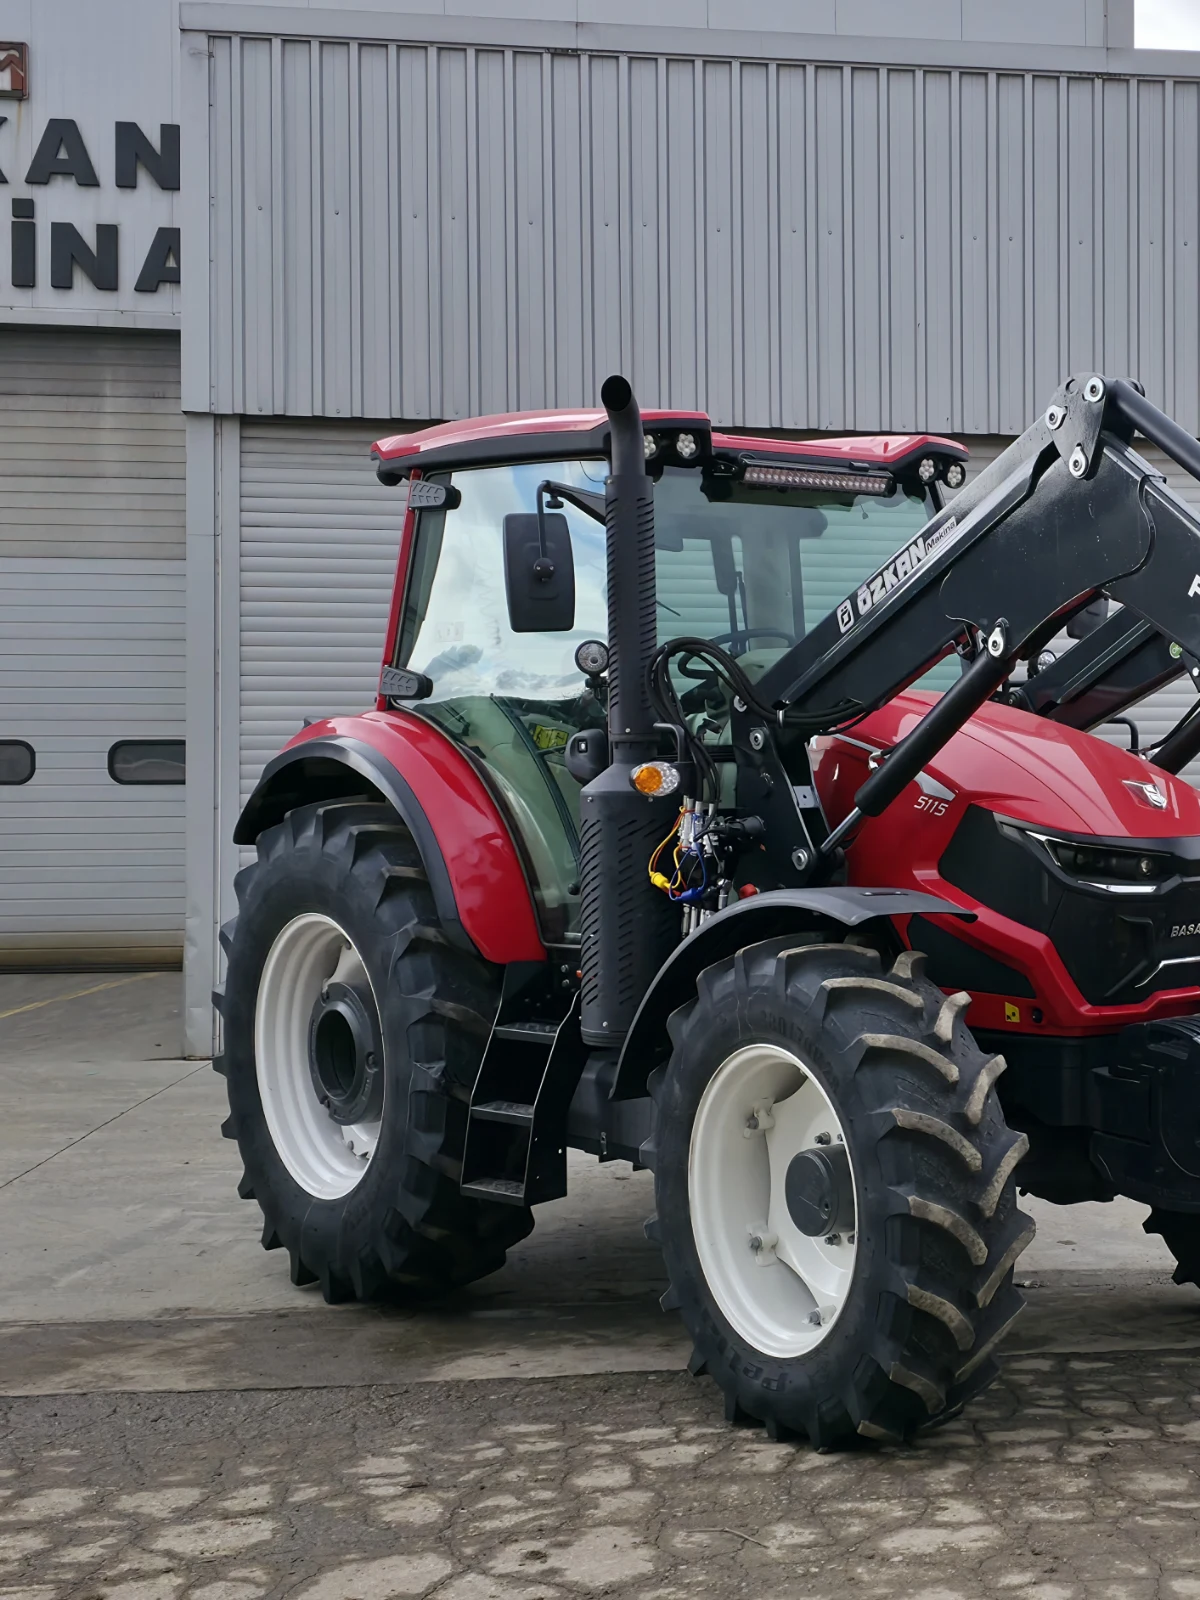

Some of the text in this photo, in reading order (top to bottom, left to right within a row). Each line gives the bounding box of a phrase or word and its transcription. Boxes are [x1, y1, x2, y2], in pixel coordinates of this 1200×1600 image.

[0, 116, 180, 190] AN
[857, 537, 927, 616] ÖZKAN
[925, 521, 956, 551] Makina
[913, 795, 949, 817] 5115
